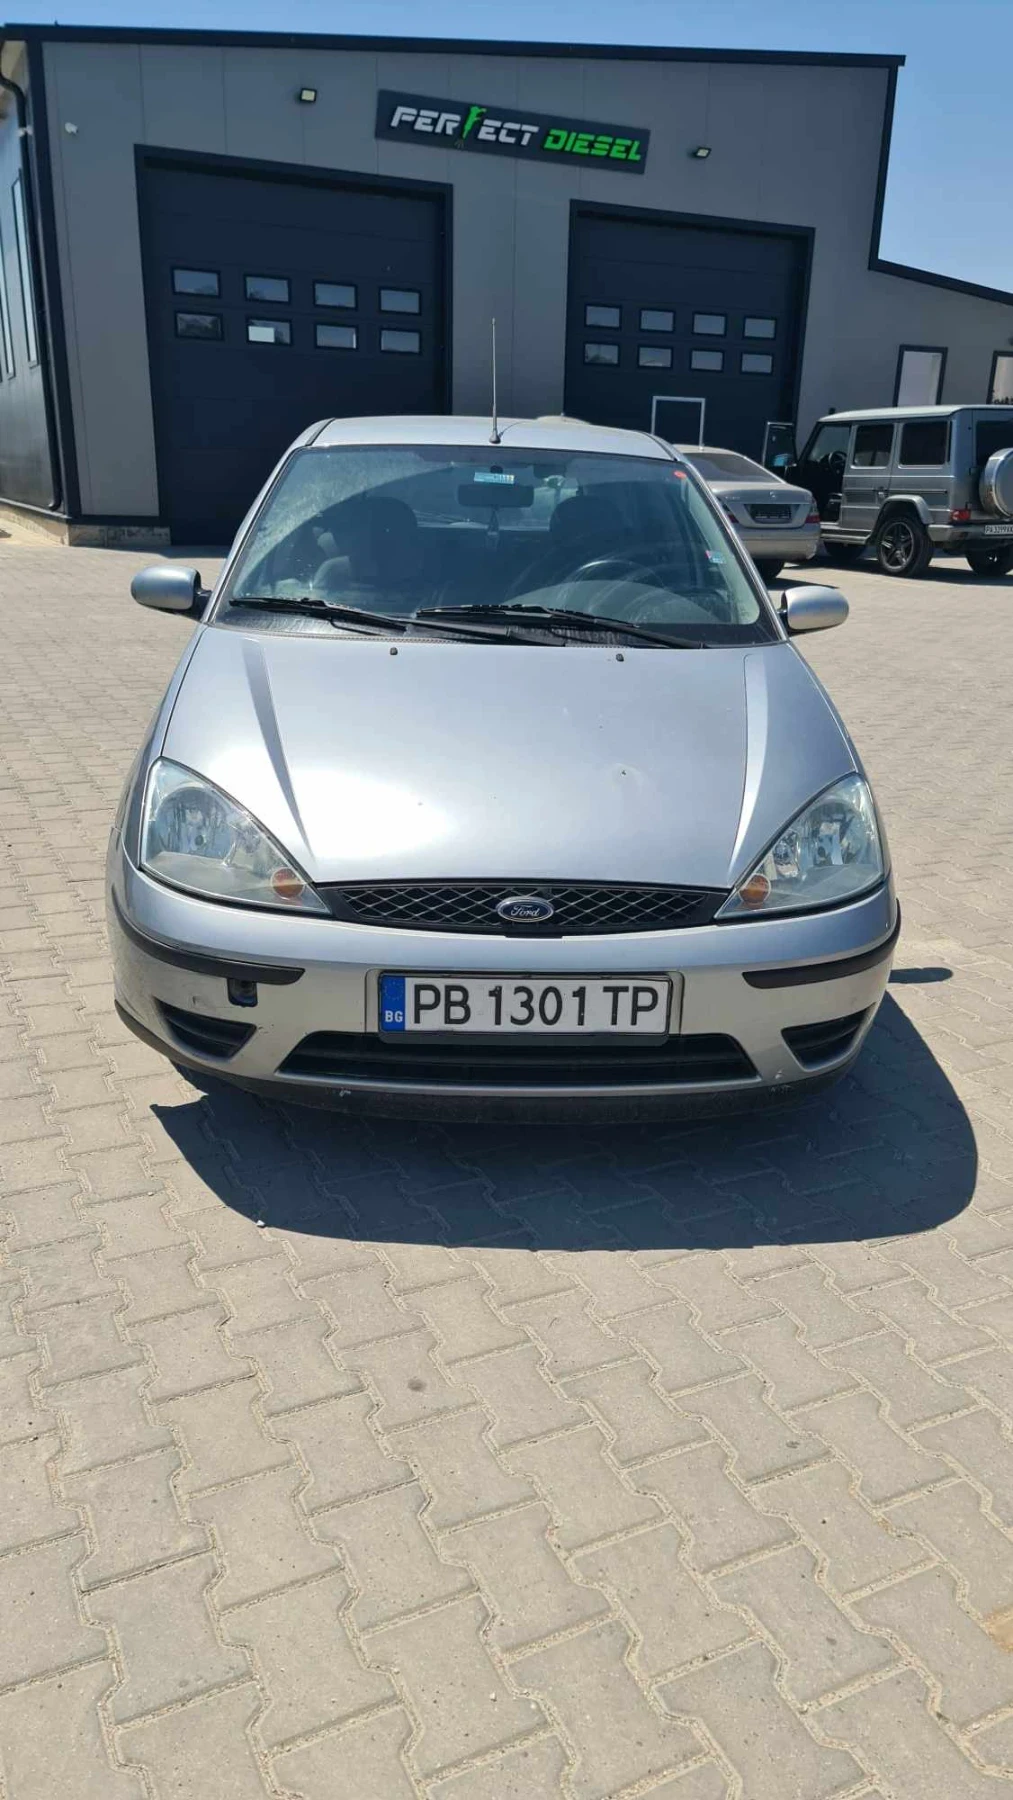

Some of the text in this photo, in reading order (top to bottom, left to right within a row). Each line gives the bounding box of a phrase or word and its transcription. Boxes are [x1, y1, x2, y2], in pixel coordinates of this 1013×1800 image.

[390, 105, 641, 161] PERFECT DIESEL
[510, 905, 541, 917] Ford
[384, 1010, 403, 1023] BG
[413, 984, 659, 1026] PB 1301 TP
